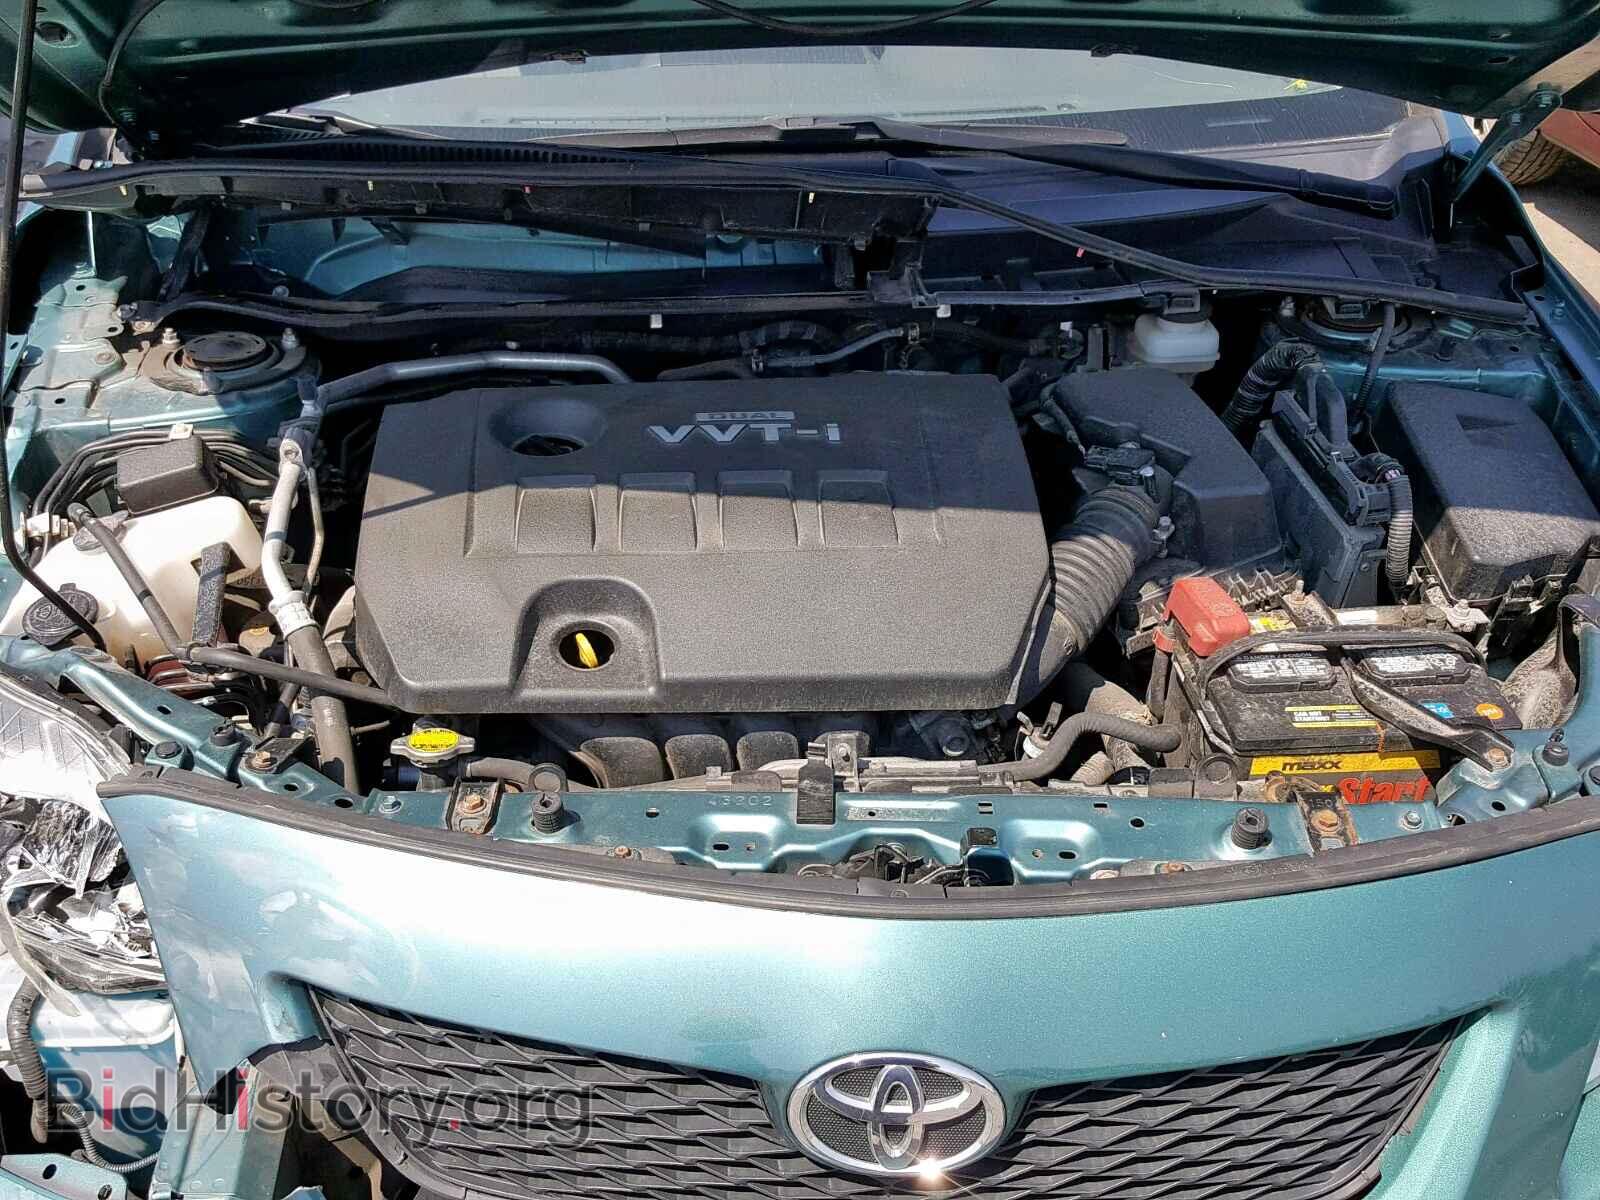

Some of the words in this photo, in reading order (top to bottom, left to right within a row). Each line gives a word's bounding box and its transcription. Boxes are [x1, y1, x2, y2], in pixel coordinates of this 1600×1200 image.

[703, 411, 792, 421] DUAL
[649, 423, 840, 443] VVT-i
[1338, 777, 1429, 804] Start
